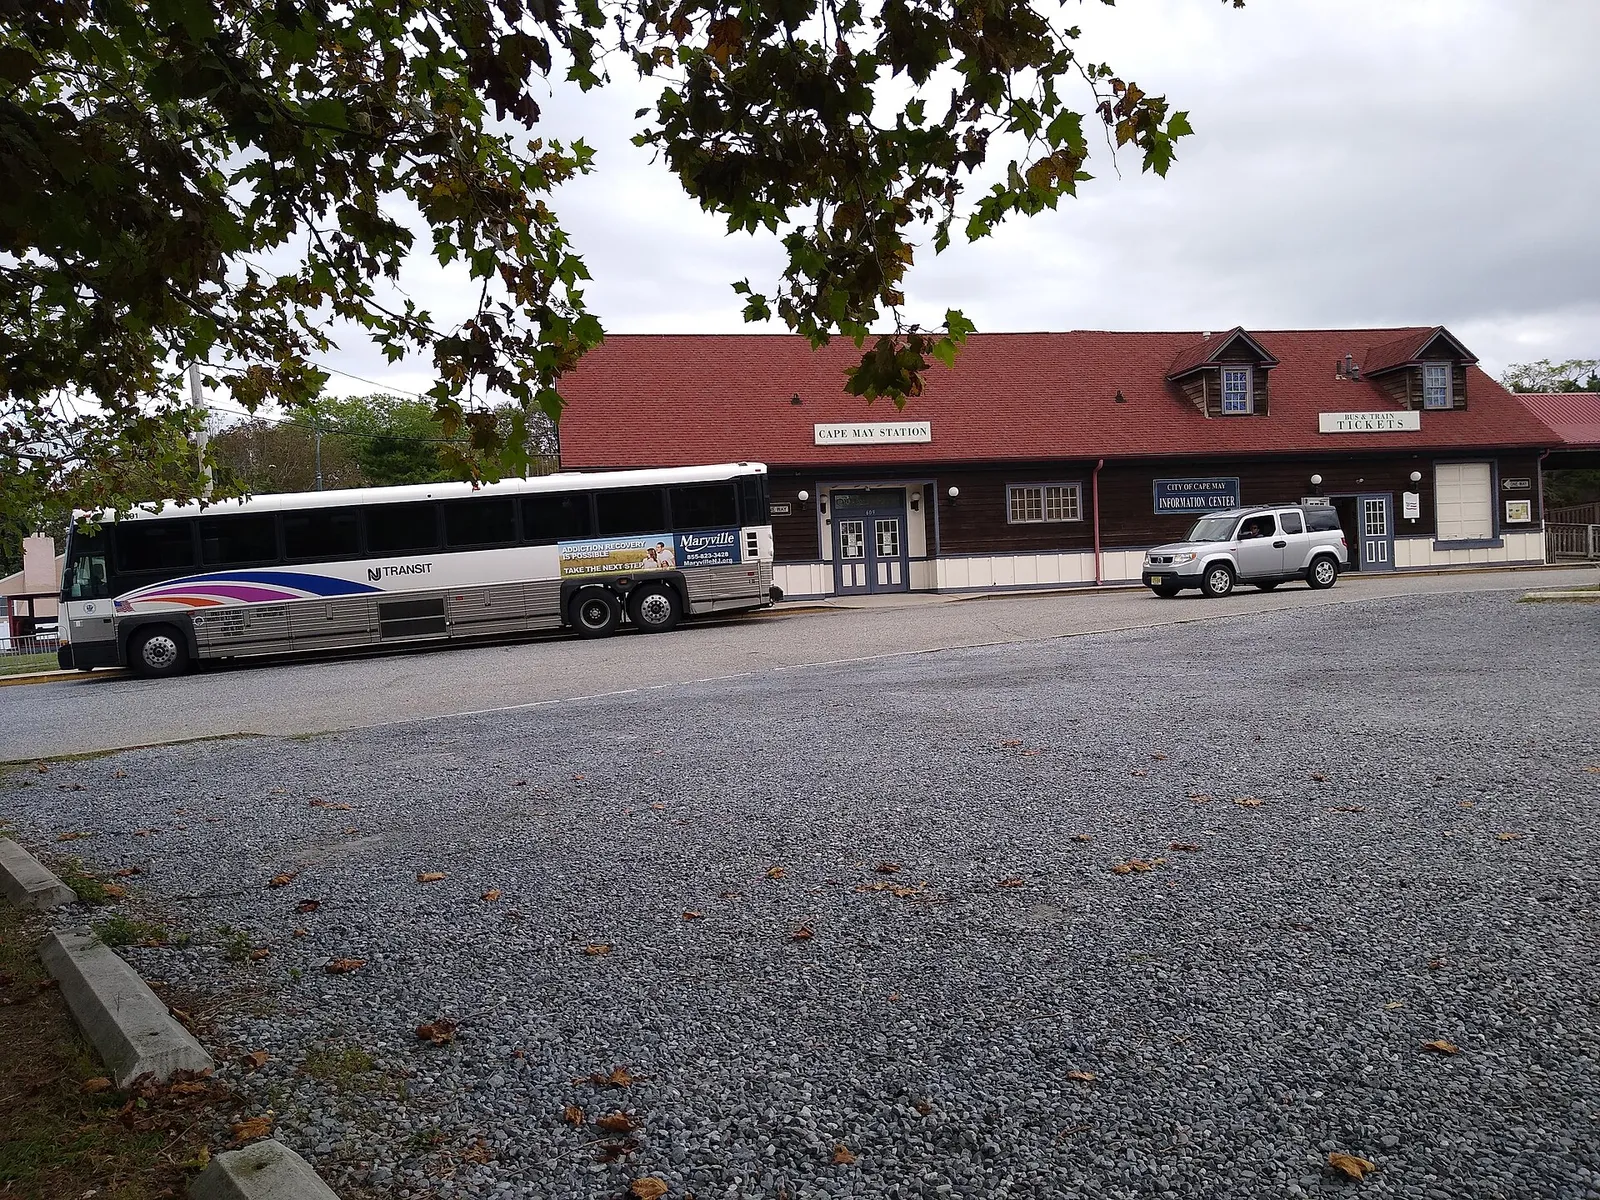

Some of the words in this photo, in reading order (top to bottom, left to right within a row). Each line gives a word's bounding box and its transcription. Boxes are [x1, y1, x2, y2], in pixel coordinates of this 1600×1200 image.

[1337, 419, 1404, 430] TICKETS
[818, 429, 848, 439] CAPE
[852, 428, 875, 438] MAY
[879, 427, 927, 437] STATION
[1167, 483, 1183, 491] CITY
[1193, 482, 1211, 490] CAPE
[1212, 482, 1226, 490] MAY
[1159, 496, 1206, 509] INFORMATION
[1208, 495, 1235, 507] CENTER
[562, 545, 604, 554] ADDICTION
[605, 541, 646, 551] RECOVERY
[680, 532, 734, 552] Maryville
[571, 551, 610, 560] POSSIBLE
[367, 567, 381, 581] NJ
[382, 563, 432, 577] TRANSIT
[563, 566, 585, 574] TAKE
[585, 565, 601, 573] THE
[623, 561, 644, 569] STEP
